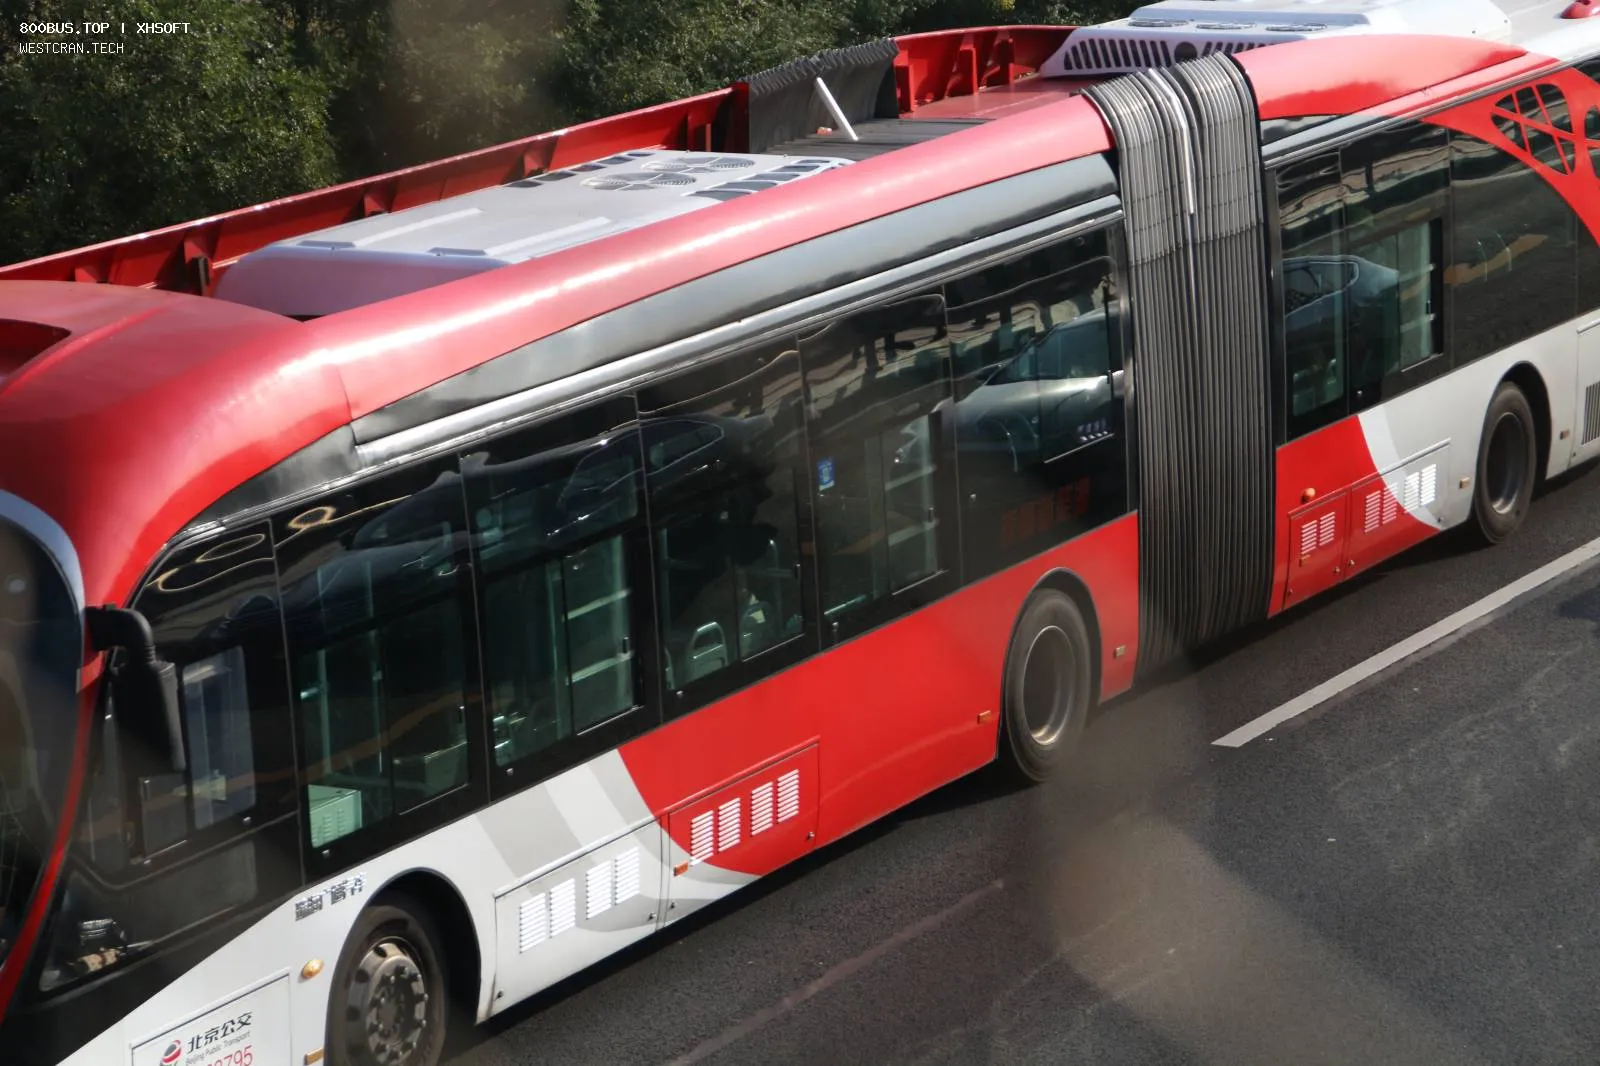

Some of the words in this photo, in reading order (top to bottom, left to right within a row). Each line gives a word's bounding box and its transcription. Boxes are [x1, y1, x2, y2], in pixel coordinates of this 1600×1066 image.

[187, 1011, 253, 1054] 北京公交
[223, 1031, 251, 1046] Transport
[207, 1044, 254, 1066] 795
